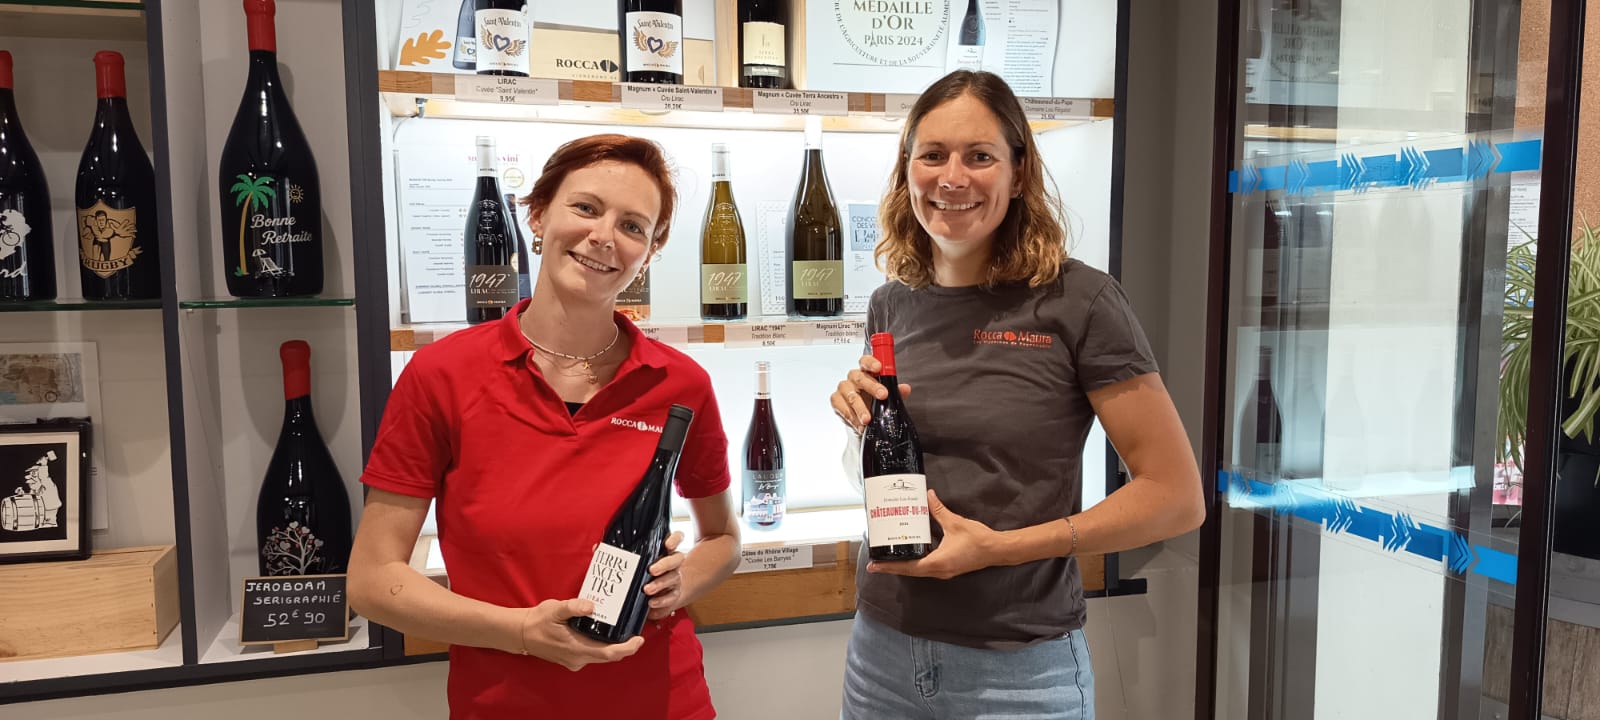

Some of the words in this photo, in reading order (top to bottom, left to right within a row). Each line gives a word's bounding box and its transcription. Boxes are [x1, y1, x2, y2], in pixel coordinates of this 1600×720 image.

[872, 14, 914, 30] D'OR
[864, 32, 894, 47] PARIS
[897, 35, 923, 46] 2024
[556, 58, 599, 70] ROCCA
[250, 214, 296, 228] Bonne
[261, 230, 312, 245] Retraite
[84, 258, 126, 269] RUGBY
[974, 328, 1002, 340] Rocca
[1018, 331, 1052, 344] Maura
[611, 417, 636, 428] ROCCA
[246, 580, 326, 592] JEROBOAM
[252, 590, 341, 605] SERIGRAPHIÉ
